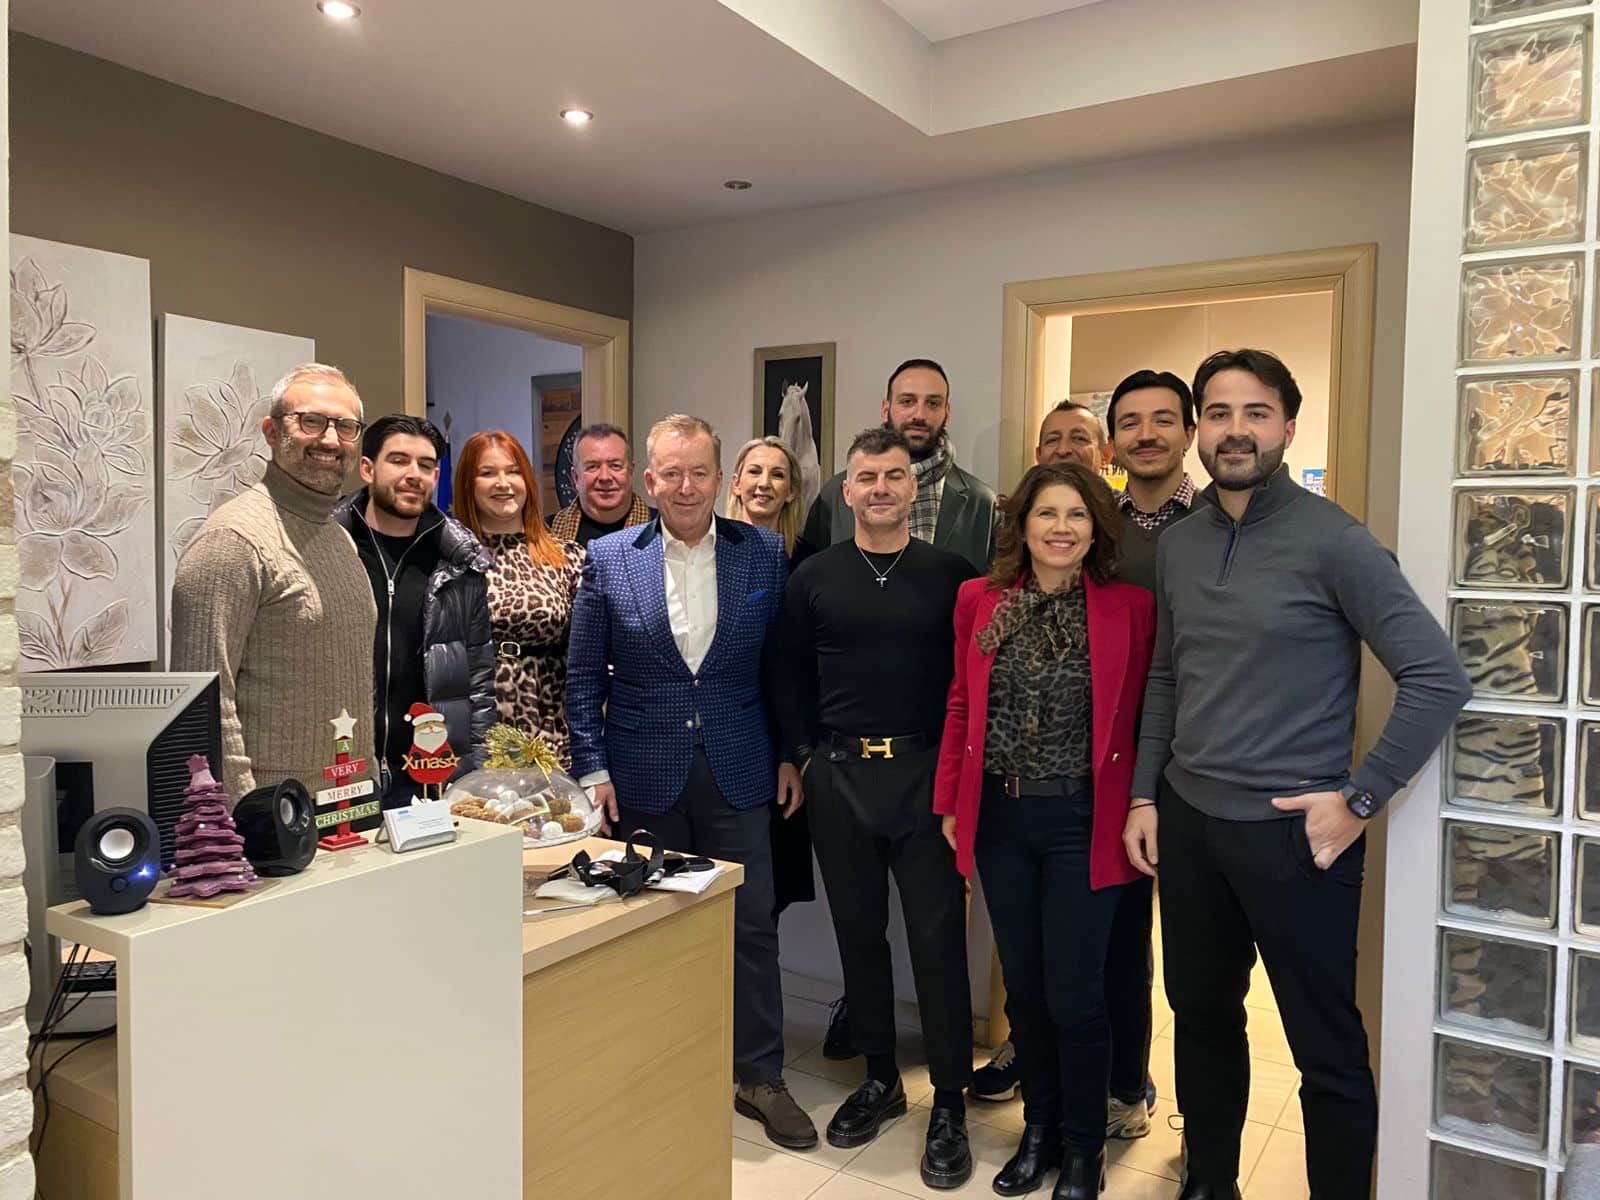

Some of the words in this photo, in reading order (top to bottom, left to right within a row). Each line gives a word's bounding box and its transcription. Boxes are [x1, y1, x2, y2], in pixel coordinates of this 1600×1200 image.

[342, 741, 350, 751] A
[330, 763, 359, 777] VERY
[401, 754, 449, 770] Xmas
[327, 785, 364, 801] MERRY
[315, 803, 378, 828] CHRISTMAS
